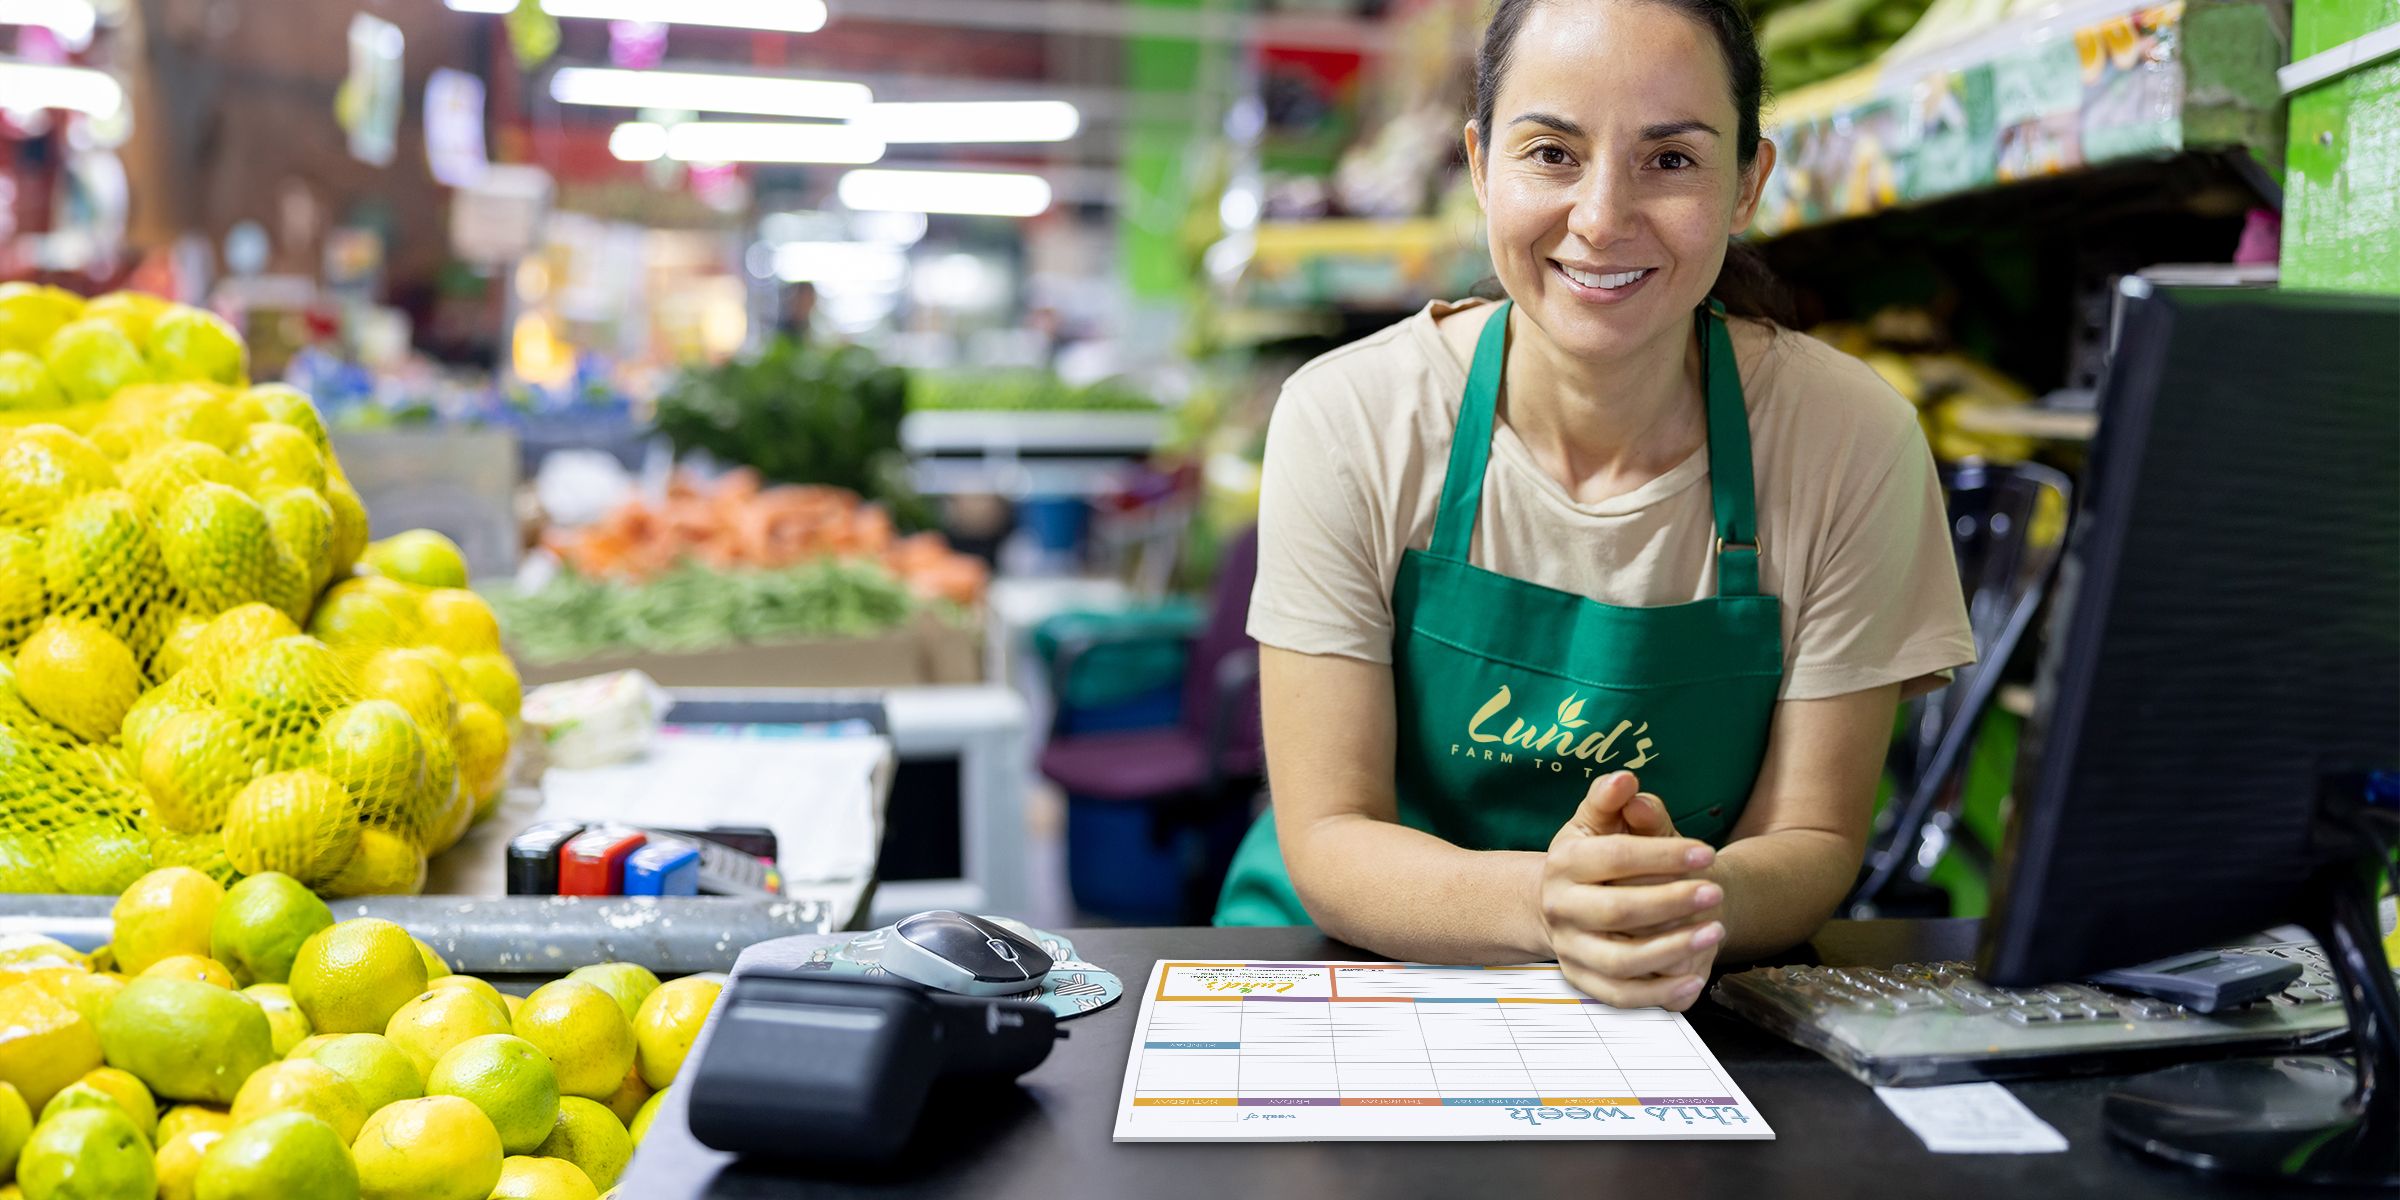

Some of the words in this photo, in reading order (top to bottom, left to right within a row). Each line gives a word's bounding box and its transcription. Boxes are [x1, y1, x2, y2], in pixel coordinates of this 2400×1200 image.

[1467, 685, 1659, 769] Lund's
[1451, 744, 1513, 764] FARM
[1534, 758, 1562, 773] TO
[1242, 1112, 1259, 1121] of
[1504, 1106, 1636, 1126] week
[1643, 1106, 1750, 1125] this
